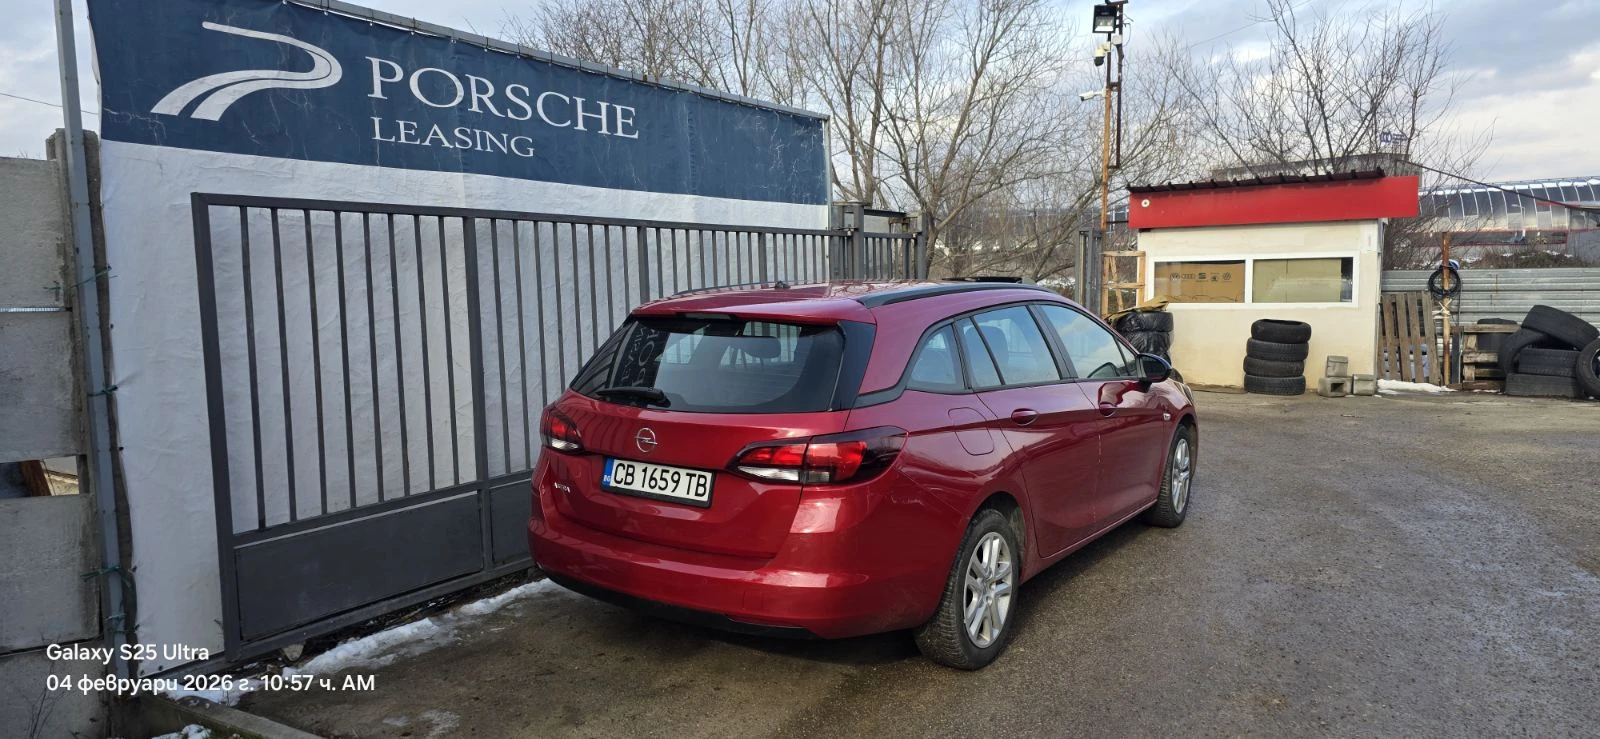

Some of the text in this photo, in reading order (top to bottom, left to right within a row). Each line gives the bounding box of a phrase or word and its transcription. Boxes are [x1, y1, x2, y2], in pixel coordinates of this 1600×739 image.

[365, 56, 639, 139] PORSCHE
[370, 116, 534, 157] LEASING
[613, 463, 636, 487] CB
[641, 466, 682, 494] 1659
[685, 472, 708, 498] TB
